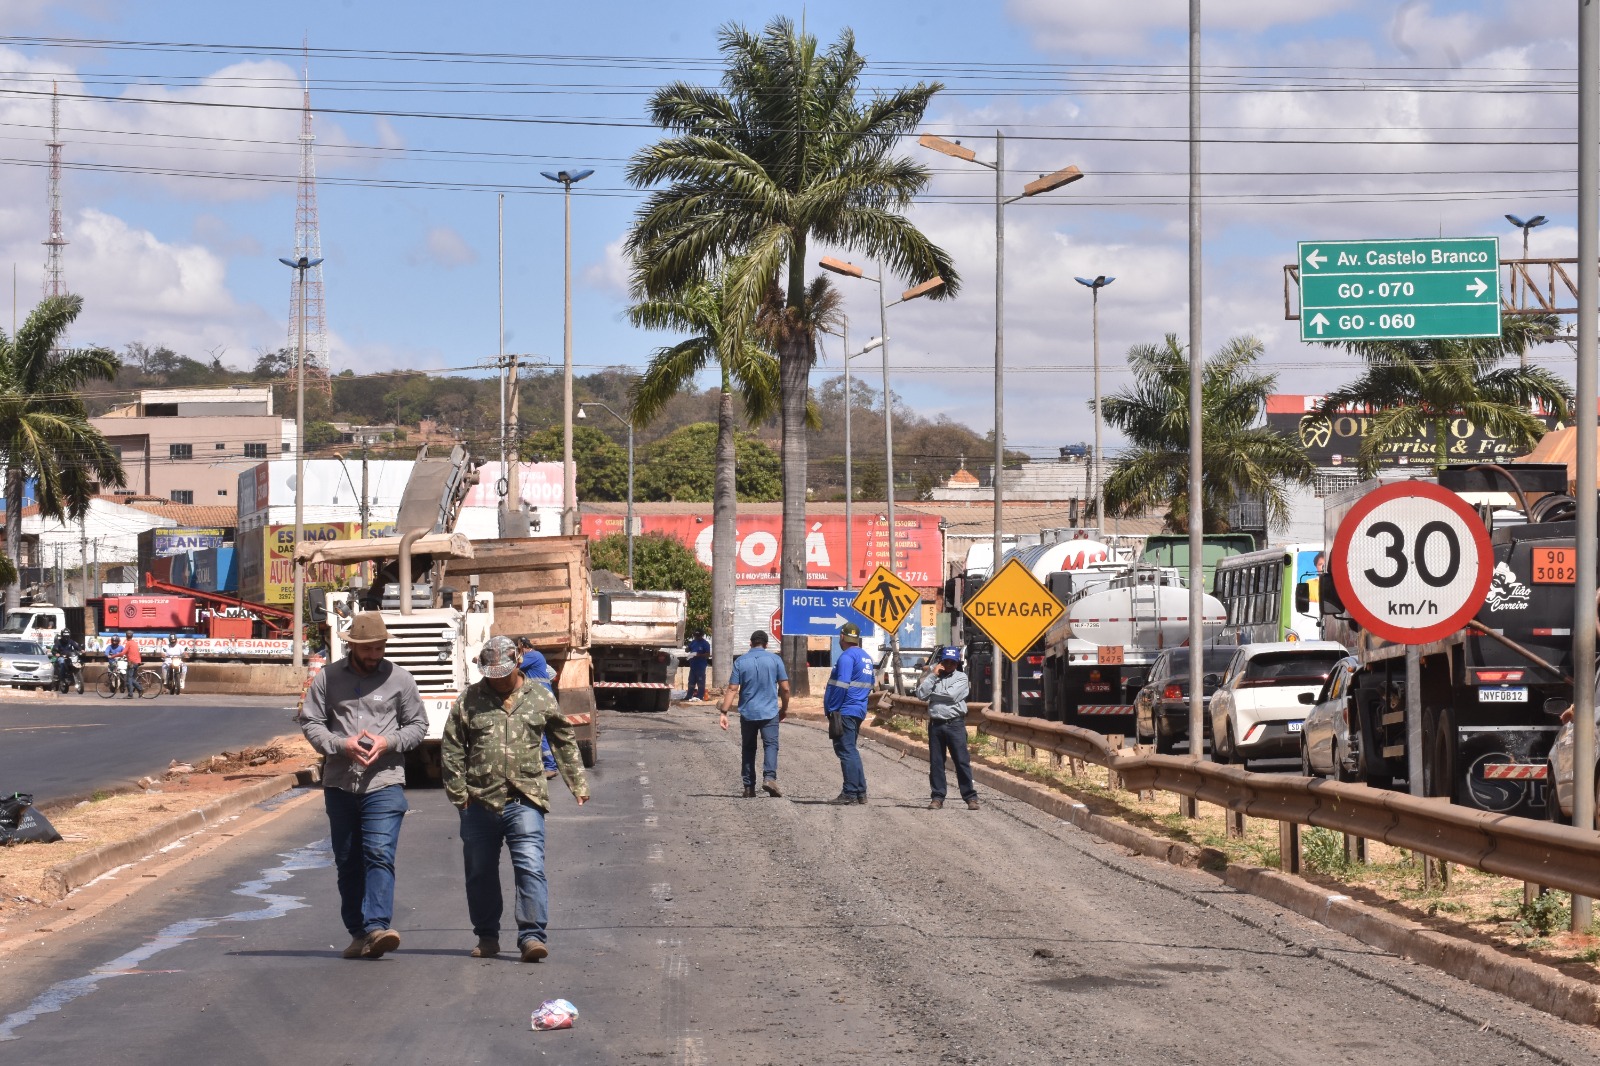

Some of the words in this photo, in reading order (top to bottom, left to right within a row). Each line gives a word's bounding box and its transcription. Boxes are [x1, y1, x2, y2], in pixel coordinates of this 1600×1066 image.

[1337, 251, 1361, 266] Av.
[1366, 250, 1426, 266] Castelo
[1431, 249, 1488, 265] Branco
[1338, 283, 1364, 298] GO
[1378, 281, 1414, 297] 070
[1338, 314, 1364, 330] GO
[1379, 313, 1415, 329] 060
[1450, 440, 1469, 454] &
[155, 536, 223, 549] PLANETA
[277, 527, 337, 544] ESINÃO
[1363, 520, 1461, 589] 30
[1547, 551, 1565, 564] 90
[1537, 567, 1575, 580] 3082
[1508, 582, 1532, 596] Tião
[792, 596, 827, 607] HOTEL
[832, 597, 854, 608] SEV
[1388, 599, 1438, 615] km/h
[1490, 600, 1528, 613] Carreiro
[975, 602, 1053, 617] DEVAGAR
[214, 639, 288, 649] ARTESIANOS
[1100, 654, 1122, 663] 3475
